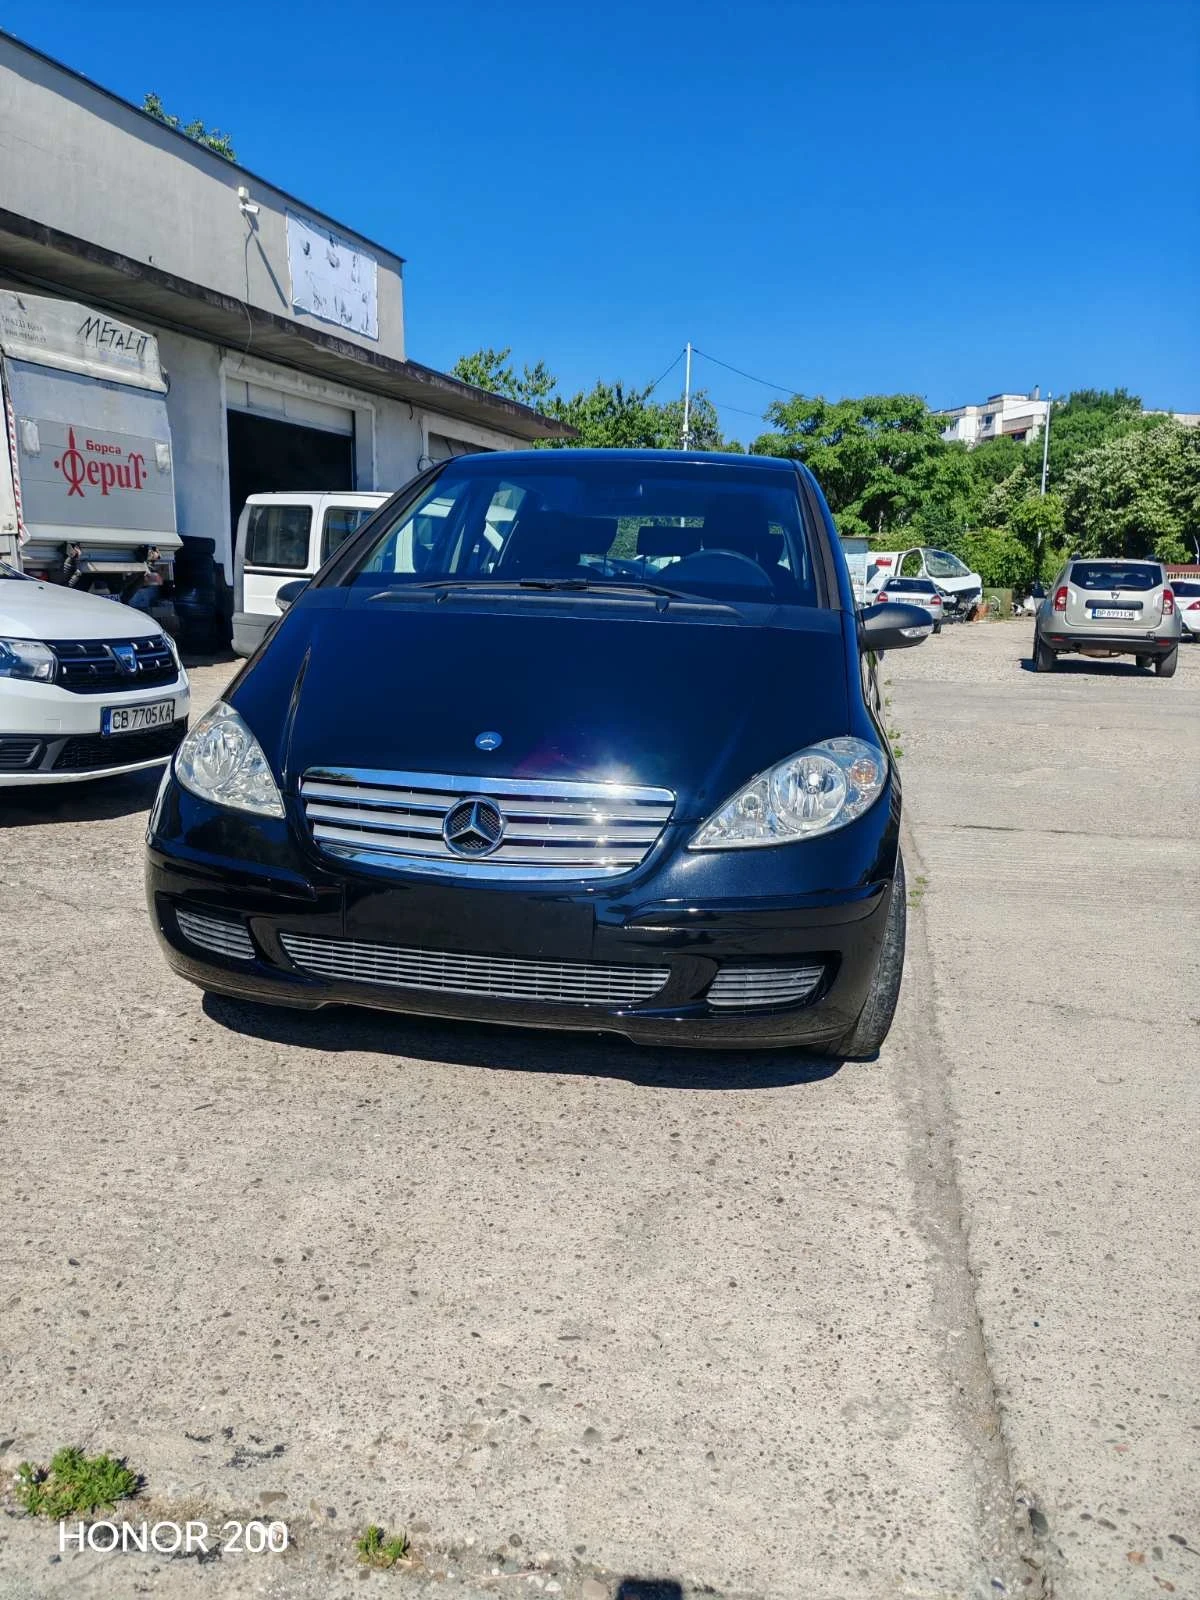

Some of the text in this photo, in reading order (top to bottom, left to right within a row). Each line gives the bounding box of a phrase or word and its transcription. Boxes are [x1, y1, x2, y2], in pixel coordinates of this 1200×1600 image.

[86, 439, 122, 455] Борса
[112, 710, 129, 729] CB
[131, 705, 158, 728] 7705
